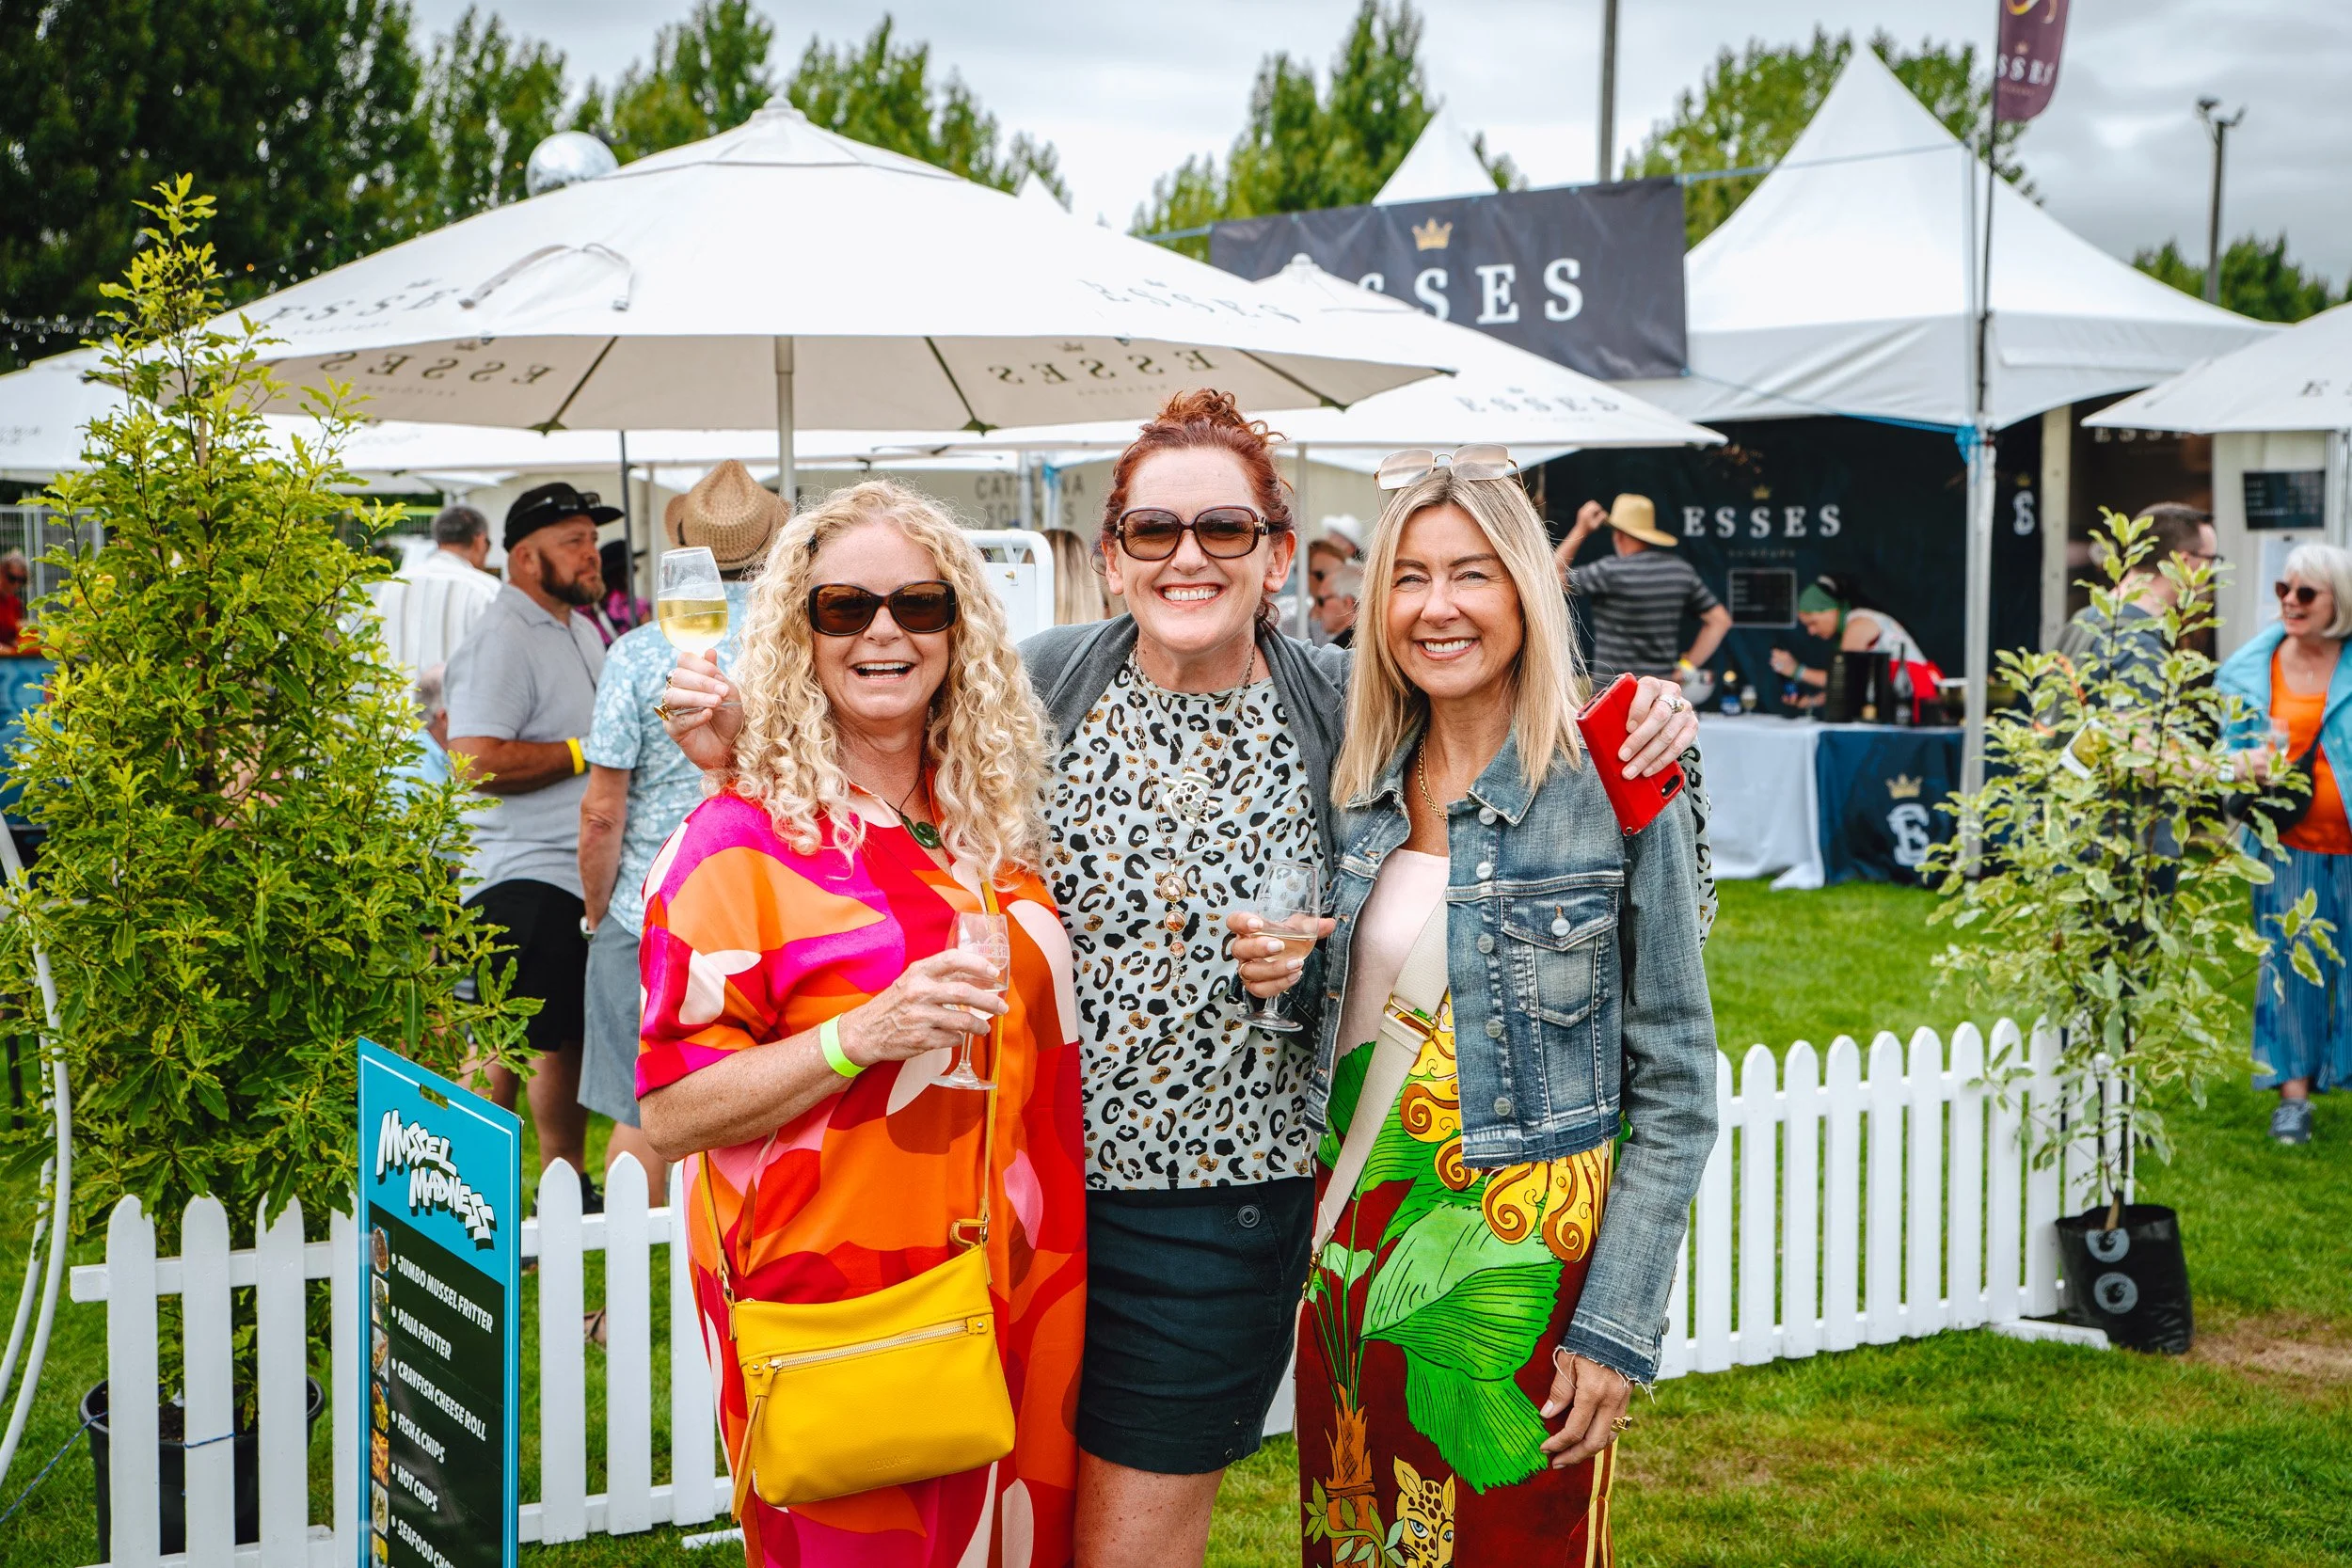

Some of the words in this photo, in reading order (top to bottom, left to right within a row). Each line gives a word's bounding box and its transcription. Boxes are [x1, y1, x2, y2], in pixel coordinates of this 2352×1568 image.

[1358, 257, 1583, 325] SES
[1682, 503, 1841, 538] ESSES
[375, 1109, 458, 1177] MUSSEL
[408, 1166, 495, 1242] MADNESS
[397, 1255, 427, 1288] JUMBO
[426, 1274, 458, 1310] MUSSEL
[458, 1295, 493, 1334] FRITTER
[398, 1308, 419, 1338] PAUA
[418, 1323, 452, 1361] FRITTER
[398, 1361, 435, 1402] CRAYFISH
[434, 1388, 466, 1425] CHEESE
[464, 1410, 486, 1442] ROLL
[397, 1413, 416, 1440] FISH
[414, 1427, 421, 1446] &
[421, 1432, 446, 1464] CHIPS
[397, 1465, 415, 1492] HOT
[414, 1480, 438, 1512] CHIPS
[397, 1519, 434, 1562] SEAFOOD
